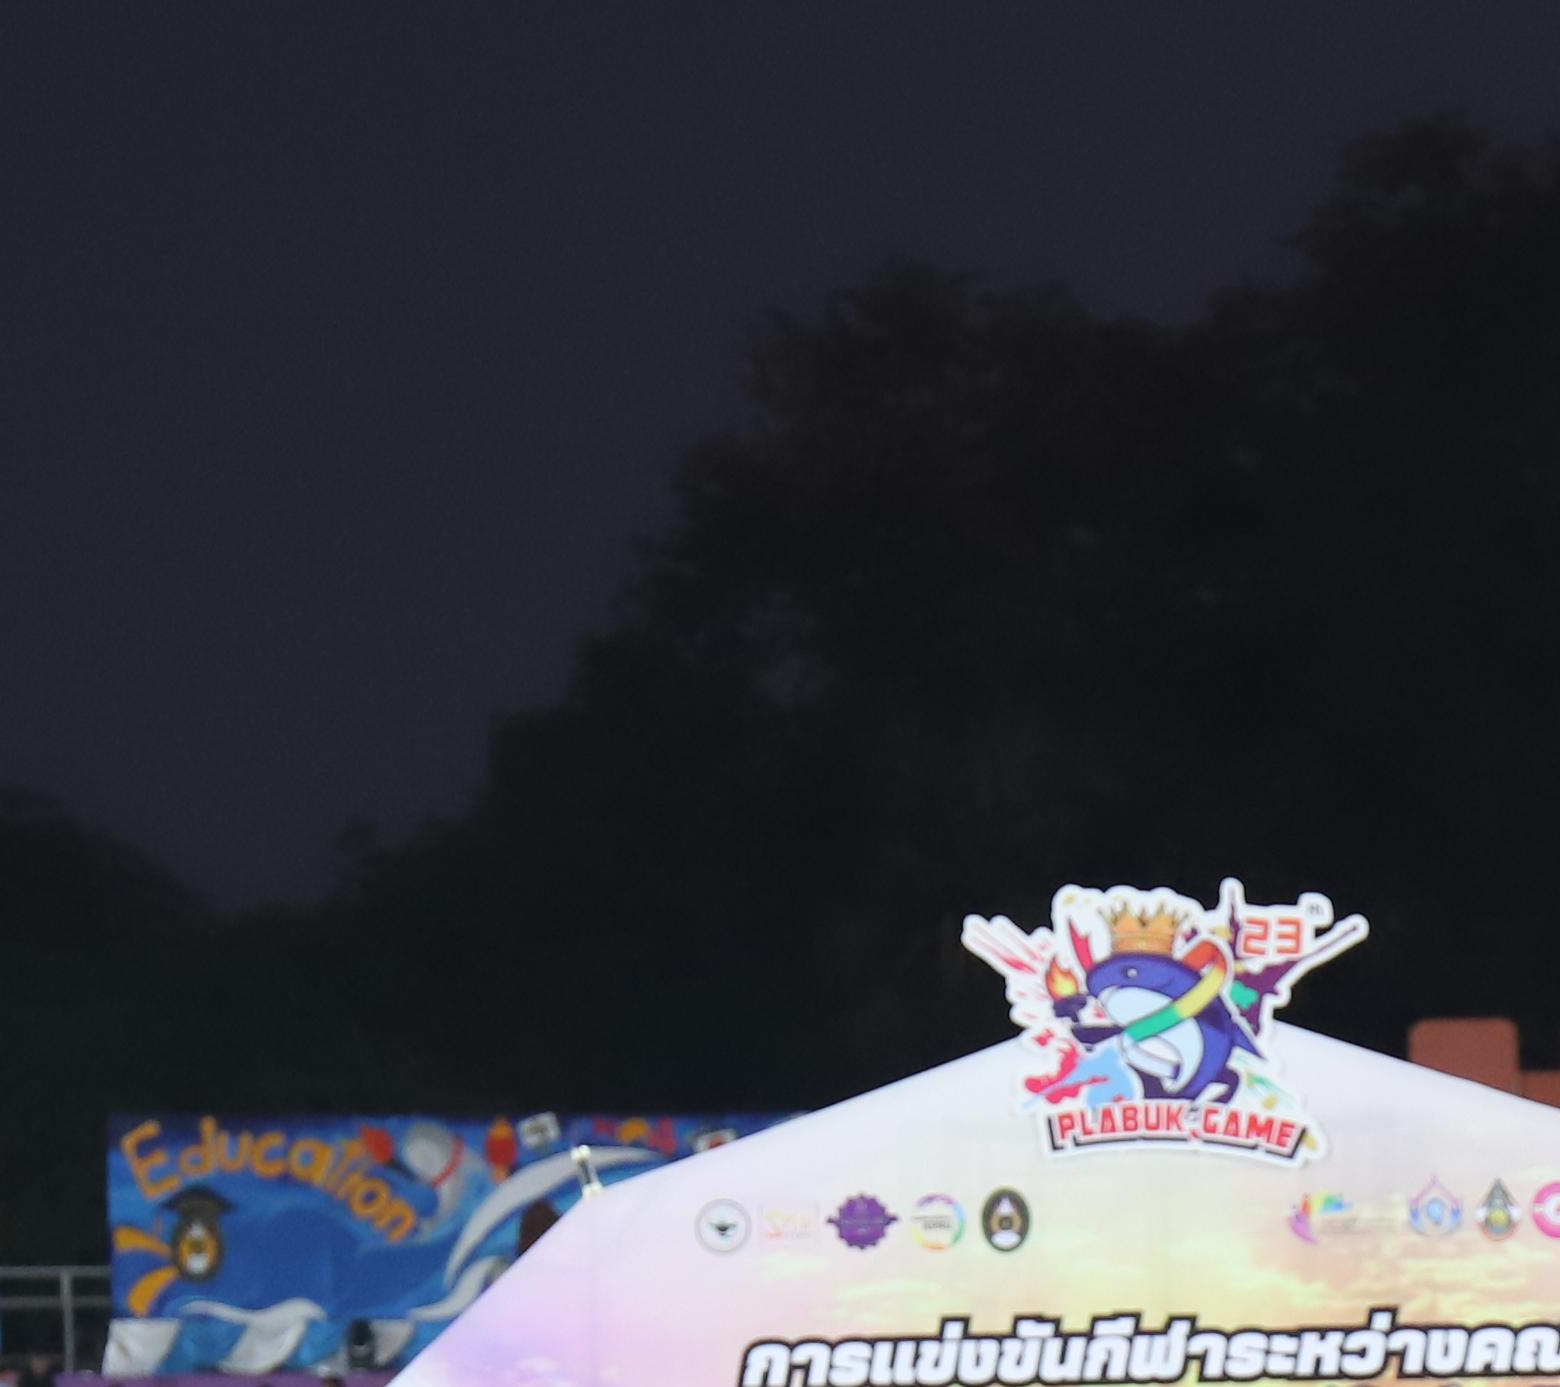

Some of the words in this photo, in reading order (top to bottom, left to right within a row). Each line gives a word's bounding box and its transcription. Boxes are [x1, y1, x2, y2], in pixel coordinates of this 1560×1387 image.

[1242, 916, 1302, 956] 23
[1056, 1104, 1184, 1141] PLABUK
[1202, 1106, 1297, 1149] GAME
[121, 1115, 418, 1244] Education
